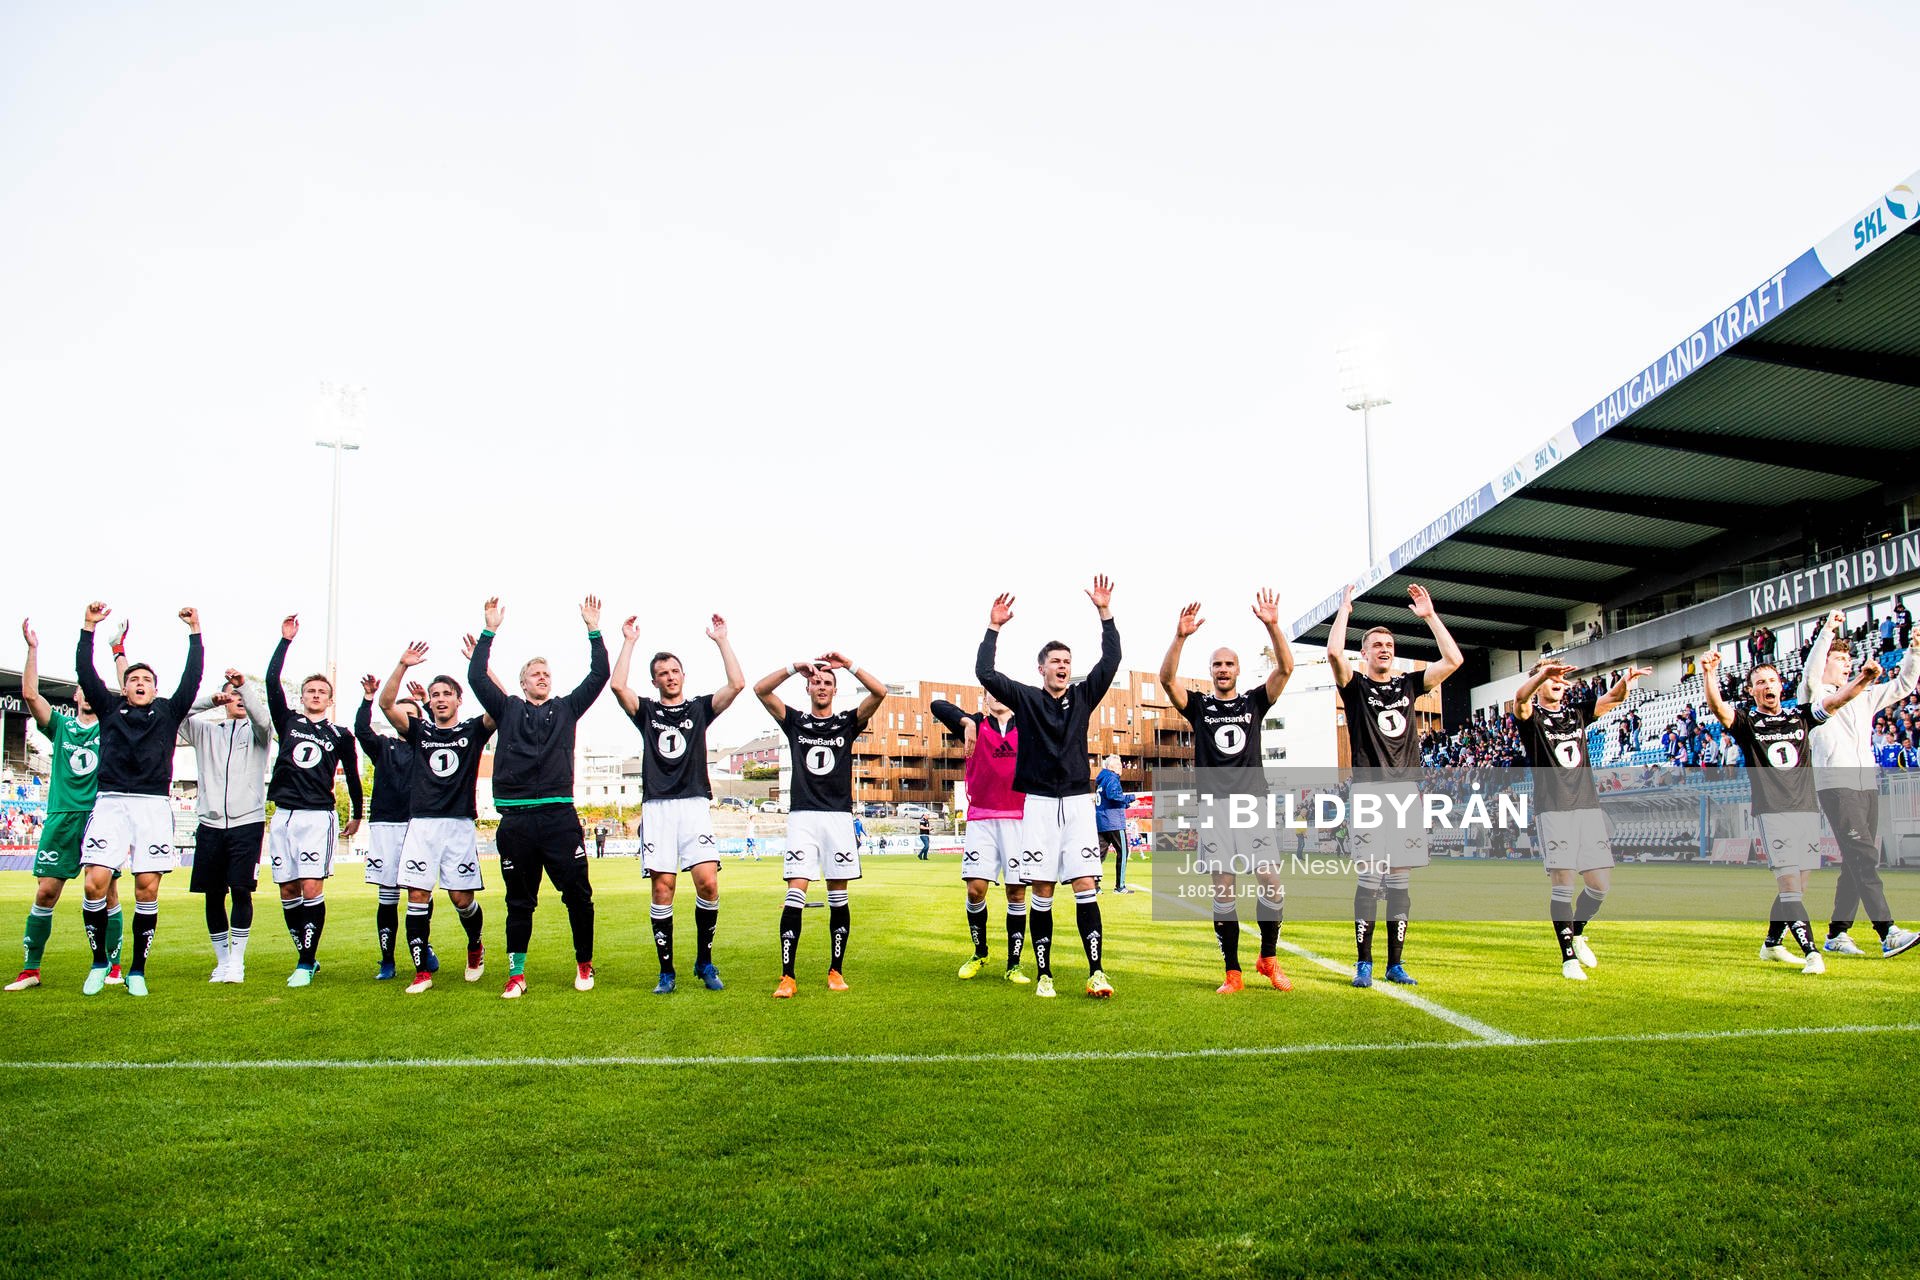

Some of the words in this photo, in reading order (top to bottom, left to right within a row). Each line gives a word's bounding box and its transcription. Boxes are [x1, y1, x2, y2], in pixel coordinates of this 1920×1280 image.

[1854, 207, 1887, 251] SKL
[1594, 331, 1707, 434] HAUGALAND
[1712, 269, 1787, 354] KRAFT
[1535, 447, 1549, 471] SKL
[1502, 471, 1515, 493] SKL
[1399, 515, 1449, 565] HAUGALAND
[1450, 490, 1481, 532] KRAFT
[1750, 533, 1920, 618] KRAFTTRIBUN
[798, 735, 836, 747] SpareBank
[783, 939, 792, 964] coop
[834, 933, 843, 958] coop
[1037, 944, 1046, 968] coop
[1090, 937, 1099, 960] coop
